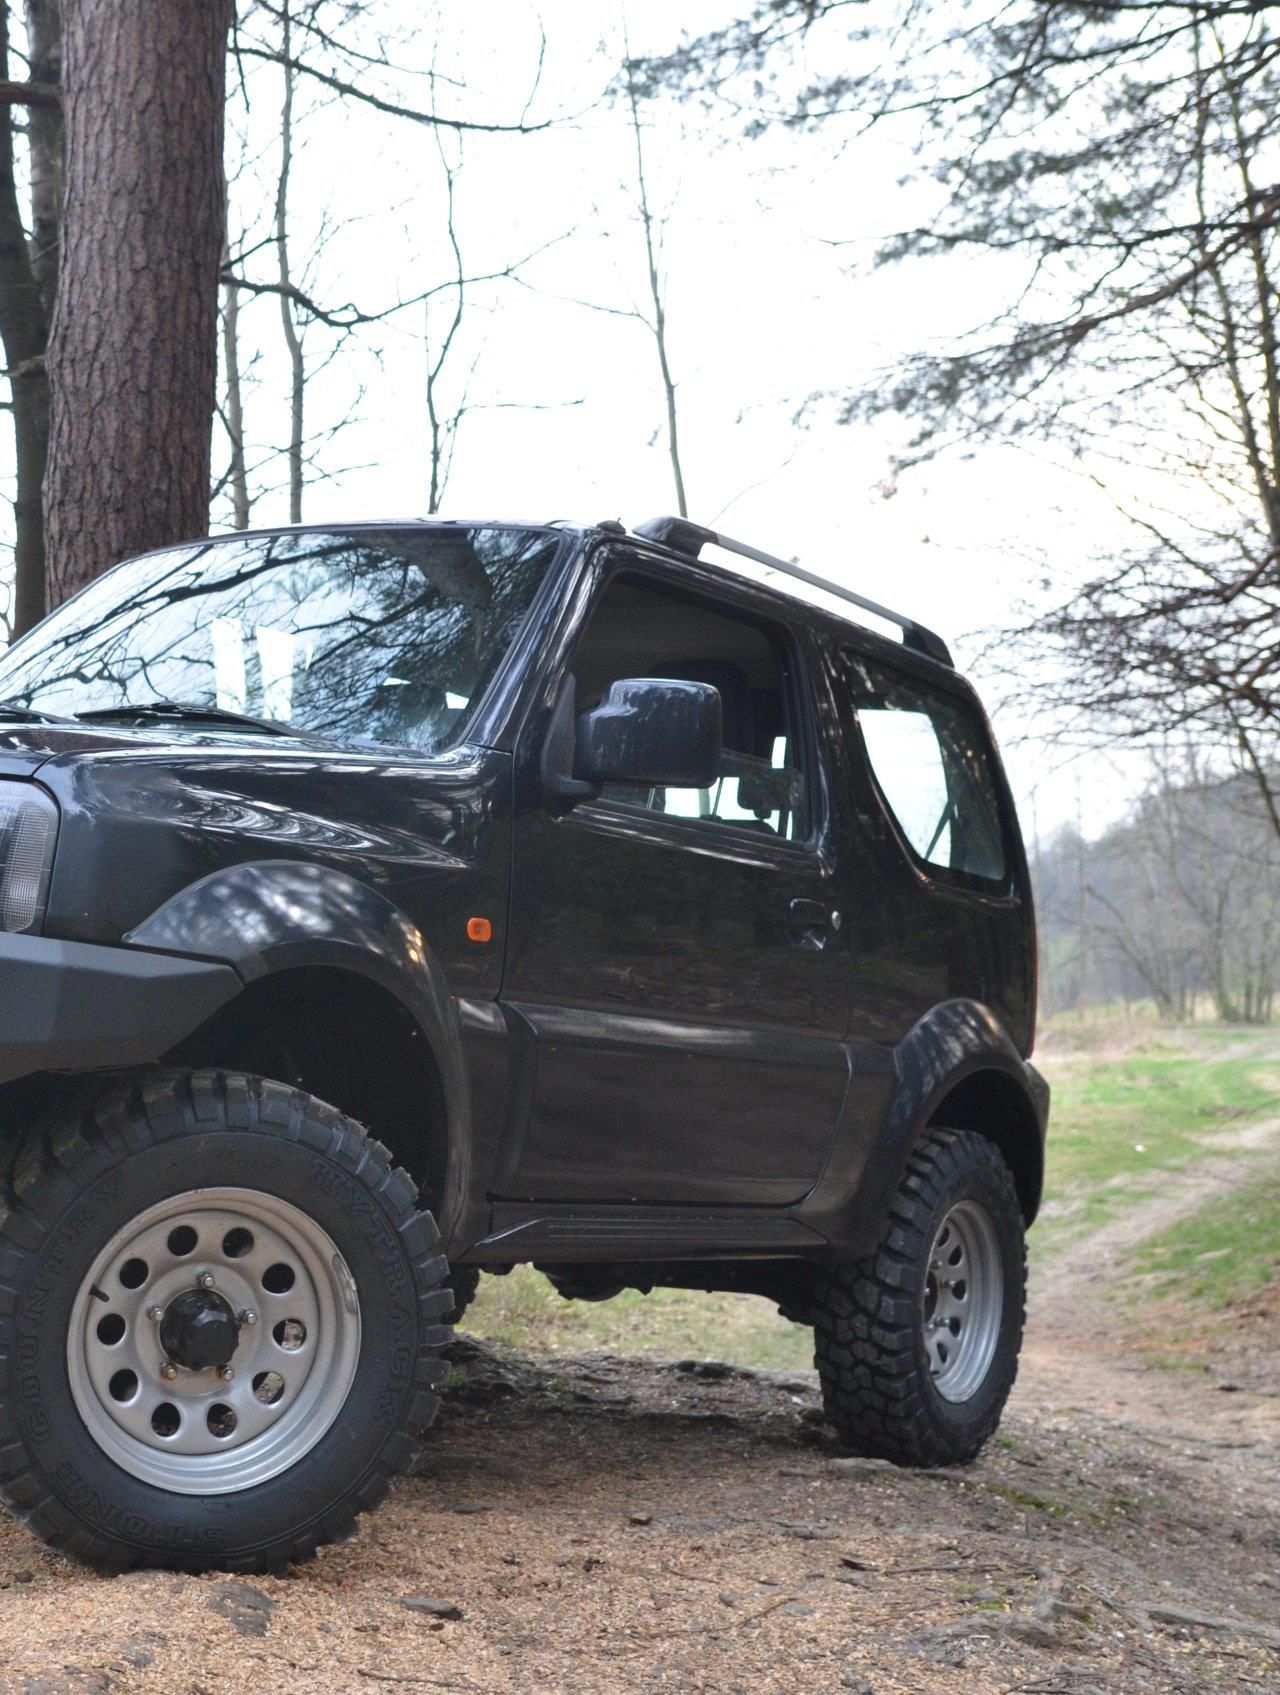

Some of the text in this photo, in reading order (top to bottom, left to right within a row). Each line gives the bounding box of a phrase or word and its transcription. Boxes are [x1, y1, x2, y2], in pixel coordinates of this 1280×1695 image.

[19, 1175, 225, 1544] STONE COUNTRY
[308, 1158, 412, 1423] HYTRACK
